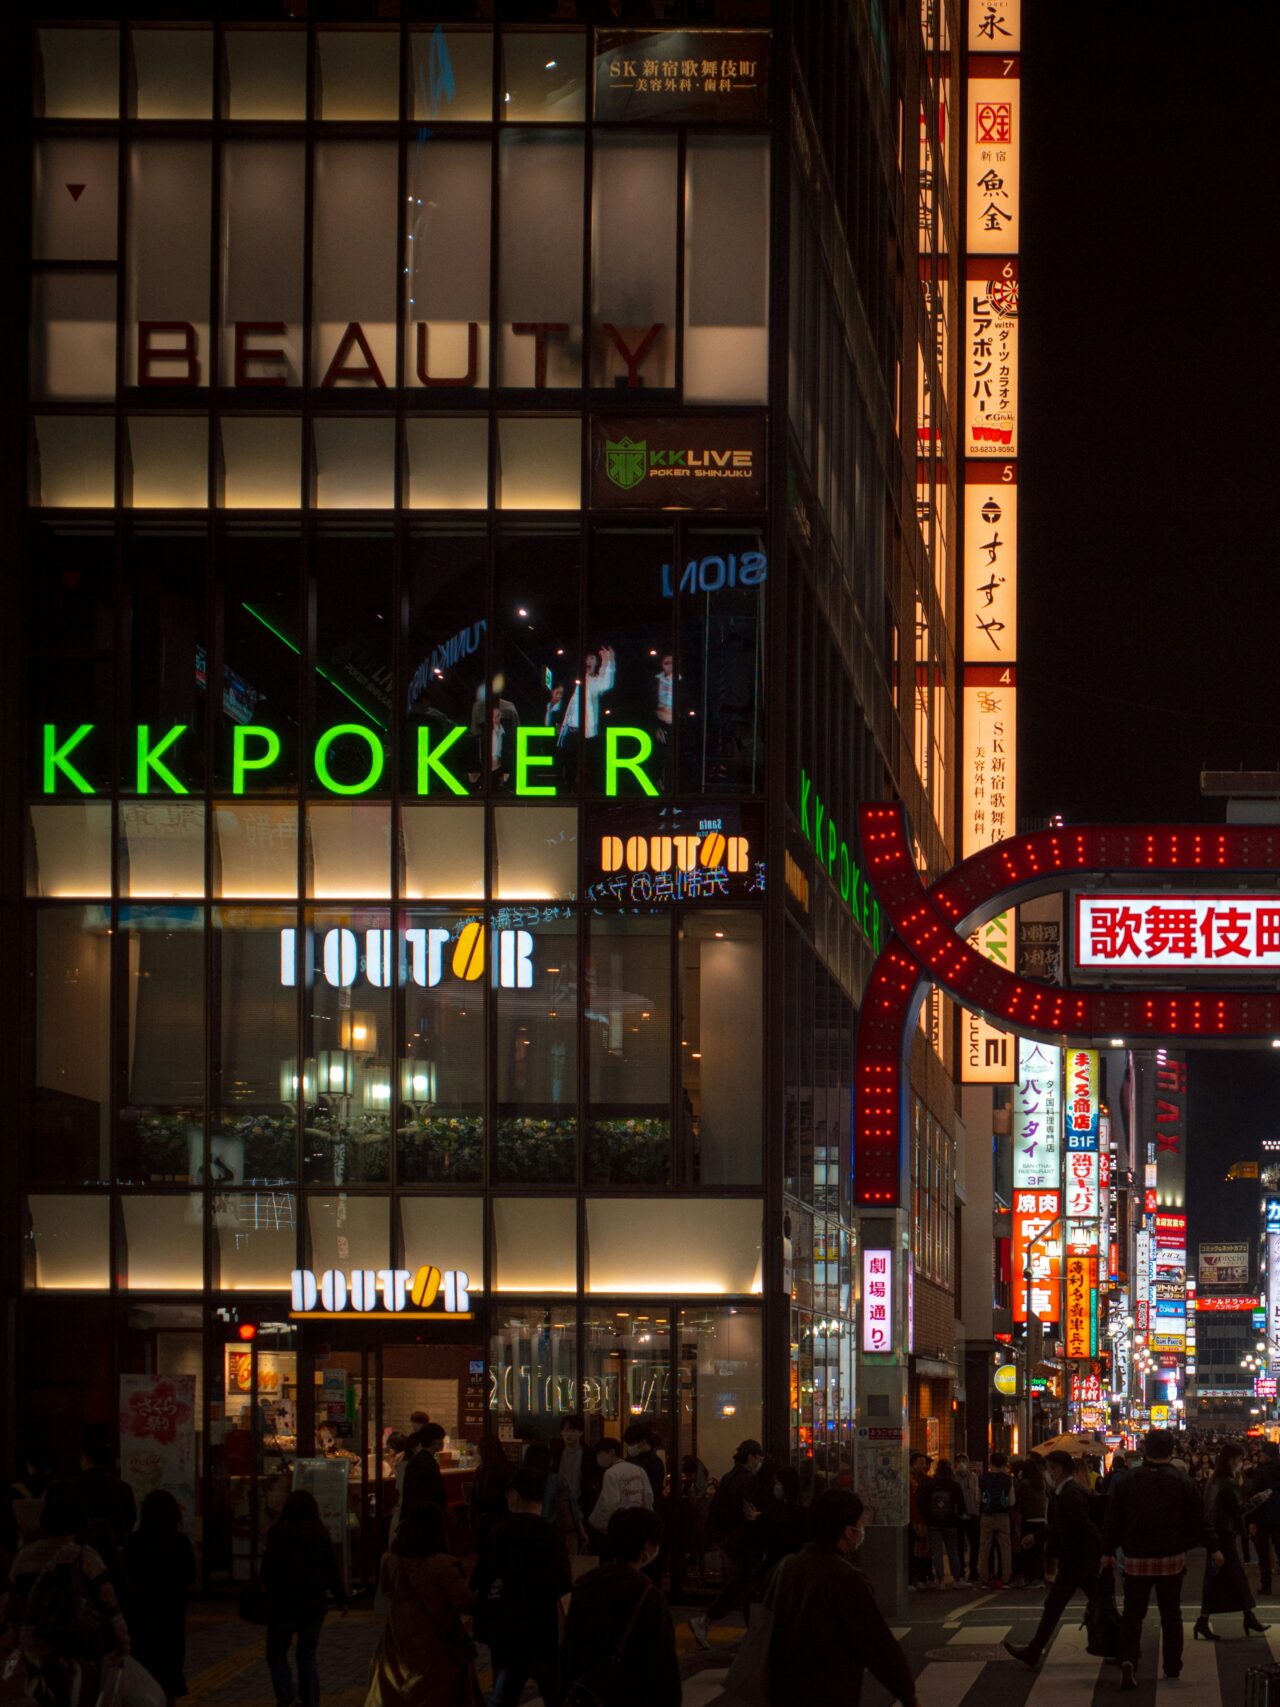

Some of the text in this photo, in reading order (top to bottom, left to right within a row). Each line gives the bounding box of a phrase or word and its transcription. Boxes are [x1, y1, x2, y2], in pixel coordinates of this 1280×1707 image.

[610, 60, 757, 77] SK 新宿歌舞伎町
[1002, 60, 1014, 76] 7
[980, 150, 1007, 162] 新宿
[977, 168, 1012, 232] 魚金
[1002, 263, 1013, 279] 6
[994, 320, 1014, 329] with
[138, 321, 665, 388] BEAUTY
[972, 296, 992, 412] ビアポンバー
[998, 330, 1010, 362] ダーツ
[998, 365, 1010, 410] カラオケ
[650, 450, 752, 466] KKLIVE
[650, 469, 752, 478] POKER SHINJUKU
[1002, 466, 1013, 482] 5
[1000, 668, 1011, 684] 4
[602, 832, 749, 872] DOUTOR
[1073, 1052, 1091, 1131] まぐろ商店
[1019, 1079, 1041, 1158] バンタイ
[1068, 1135, 1095, 1148] B1F
[1027, 1176, 1045, 1185] 3F
[1017, 1193, 1058, 1213] 焼肉
[291, 1265, 469, 1312] DOUTOR
[870, 1257, 886, 1345] 劇場通り
